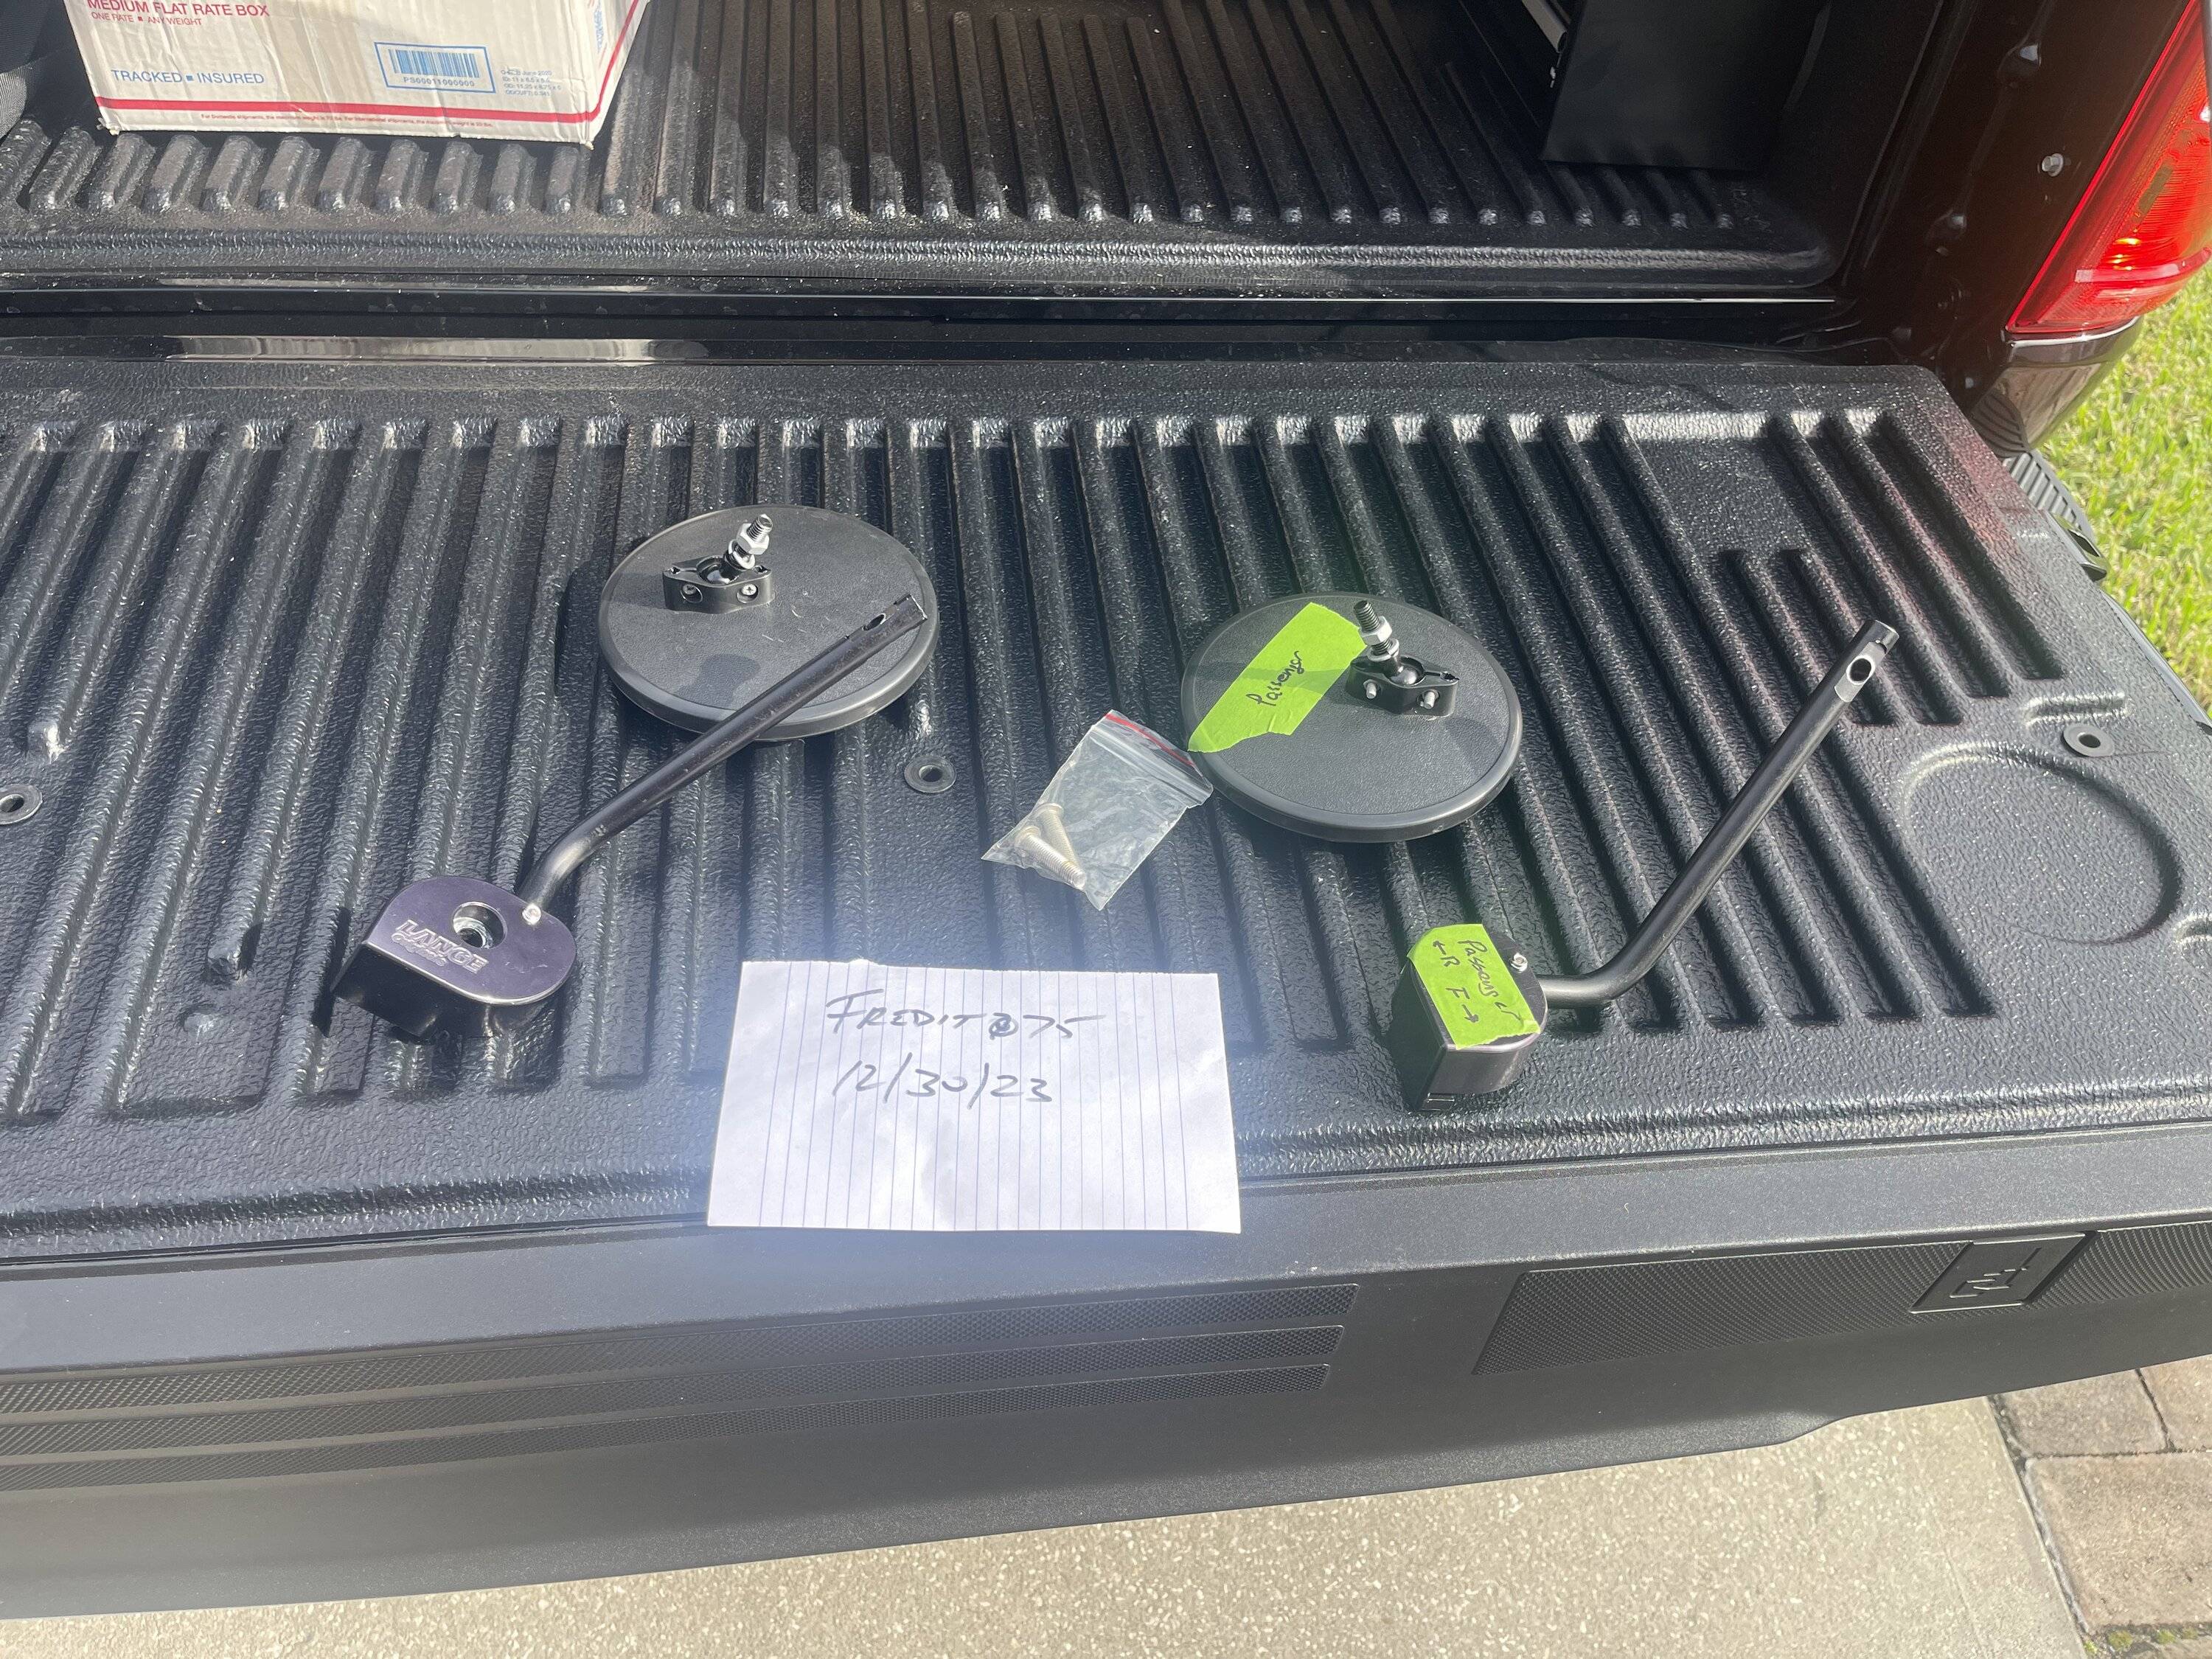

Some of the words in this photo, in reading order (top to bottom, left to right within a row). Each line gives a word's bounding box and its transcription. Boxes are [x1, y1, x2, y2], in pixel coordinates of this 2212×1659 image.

[88, 0, 150, 13] MEDIUM
[153, 3, 189, 15] FLAT
[192, 4, 233, 15] RATE
[235, 5, 270, 16] BOX
[91, 13, 111, 21] ONE
[111, 13, 134, 23] RATE
[147, 16, 165, 24] ANY
[167, 18, 202, 26] WEIGHT
[111, 69, 183, 83] TRACKED
[198, 73, 265, 84] INSURED
[832, 1052, 1052, 1110] 12/30/23
